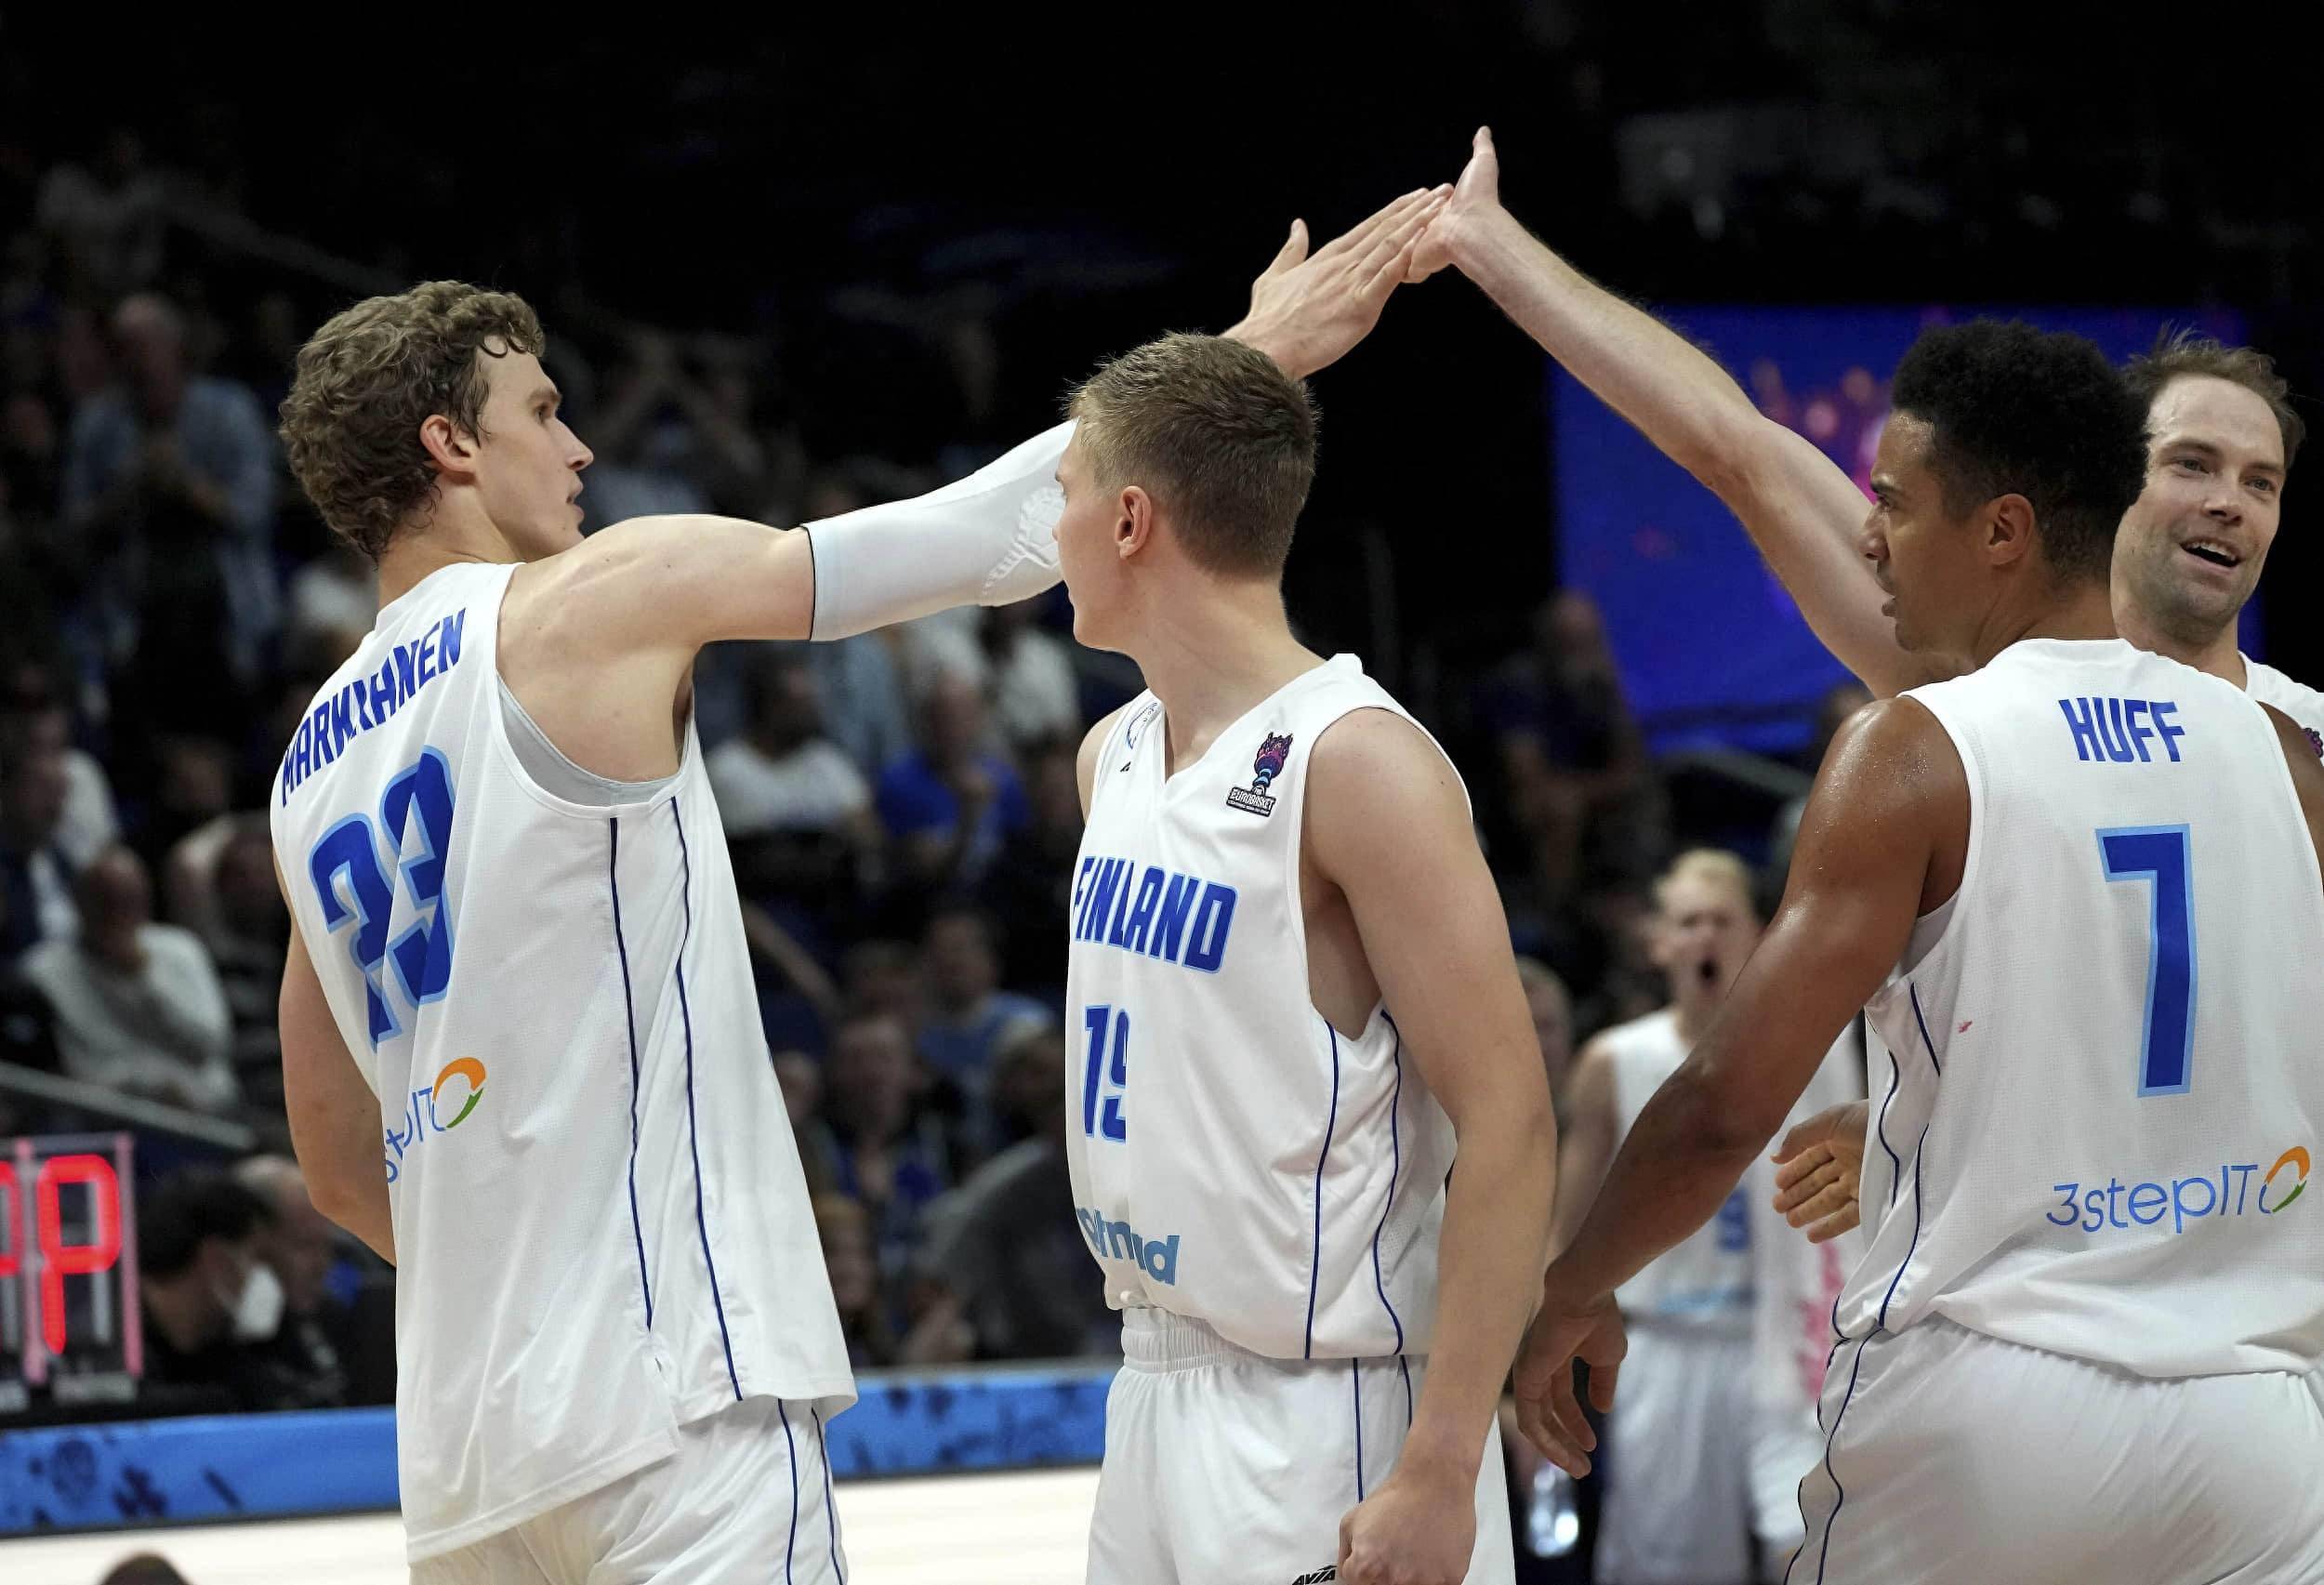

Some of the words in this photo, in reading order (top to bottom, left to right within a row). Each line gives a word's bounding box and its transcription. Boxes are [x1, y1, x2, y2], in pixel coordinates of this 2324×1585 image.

[2058, 696, 2186, 763] HUFF
[1073, 855, 1240, 973] FINLAND
[2093, 823, 2199, 1099] 7
[2045, 1164, 2259, 1235] 3stepIT
